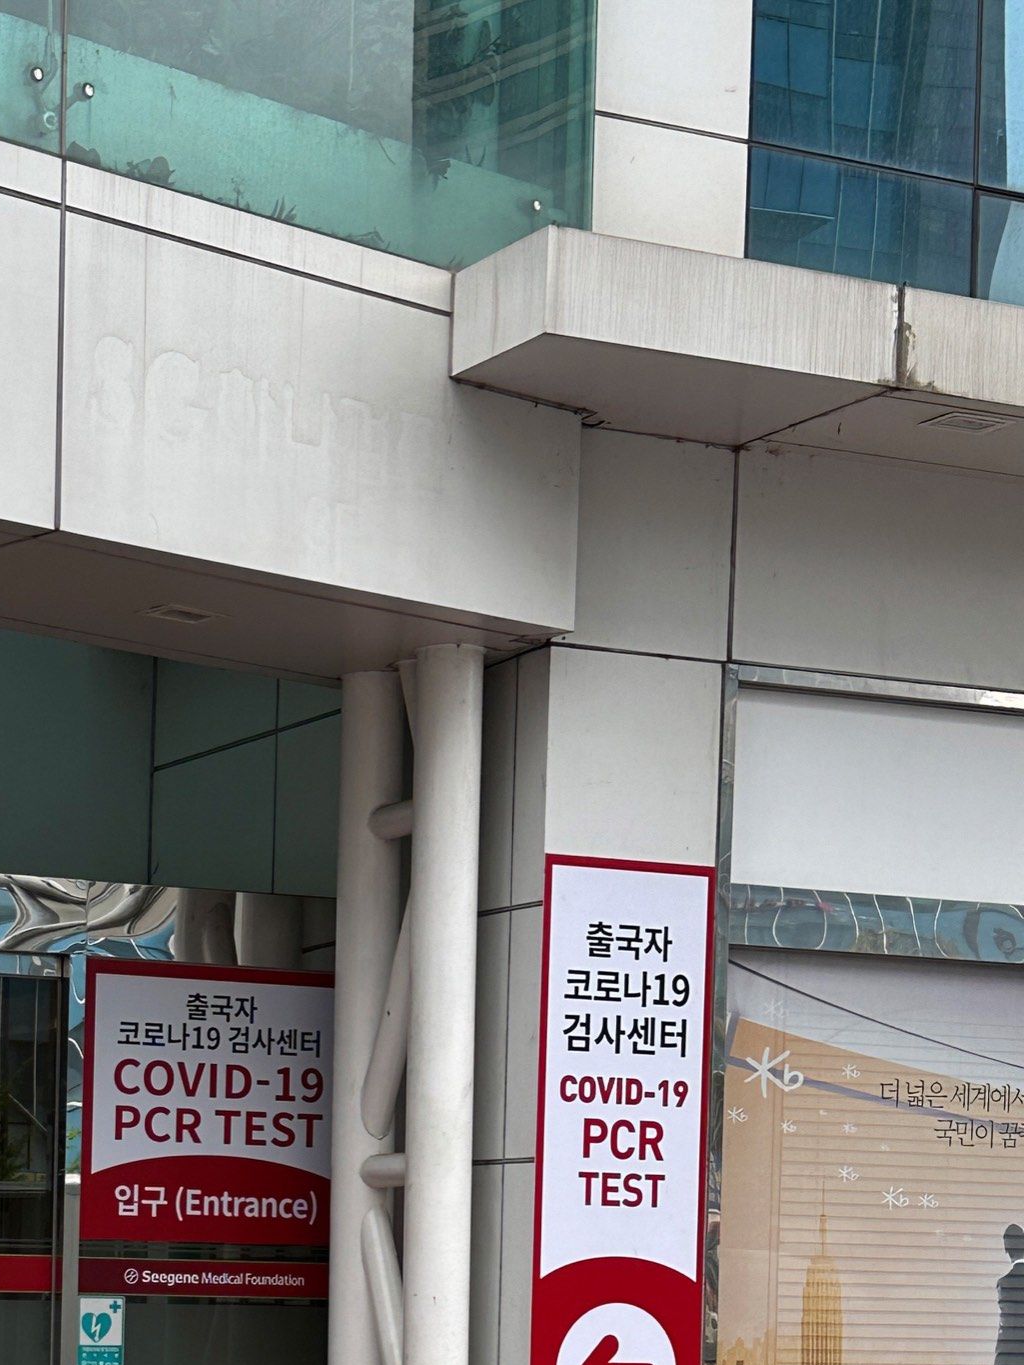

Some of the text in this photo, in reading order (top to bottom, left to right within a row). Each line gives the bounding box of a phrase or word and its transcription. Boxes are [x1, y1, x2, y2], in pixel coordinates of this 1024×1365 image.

[586, 921, 673, 962] 출국자
[564, 969, 690, 1008] 코로나19
[186, 993, 258, 1024] 출국자
[117, 1021, 321, 1057] 코로나19 검사센터
[562, 1013, 687, 1057] 검사센터
[114, 1058, 324, 1103] COVID-19
[560, 1075, 689, 1108] COVID-19
[880, 1078, 900, 1108] 더
[906, 1080, 948, 1108] 넓은
[114, 1105, 323, 1148] PCR TEST
[582, 1118, 664, 1161] PCR
[934, 1119, 994, 1149] 국민이
[114, 1184, 317, 1225] 입구 (Entrance)
[578, 1172, 666, 1208] TEST
[142, 1270, 305, 1286] Seegene Medical Foundation
